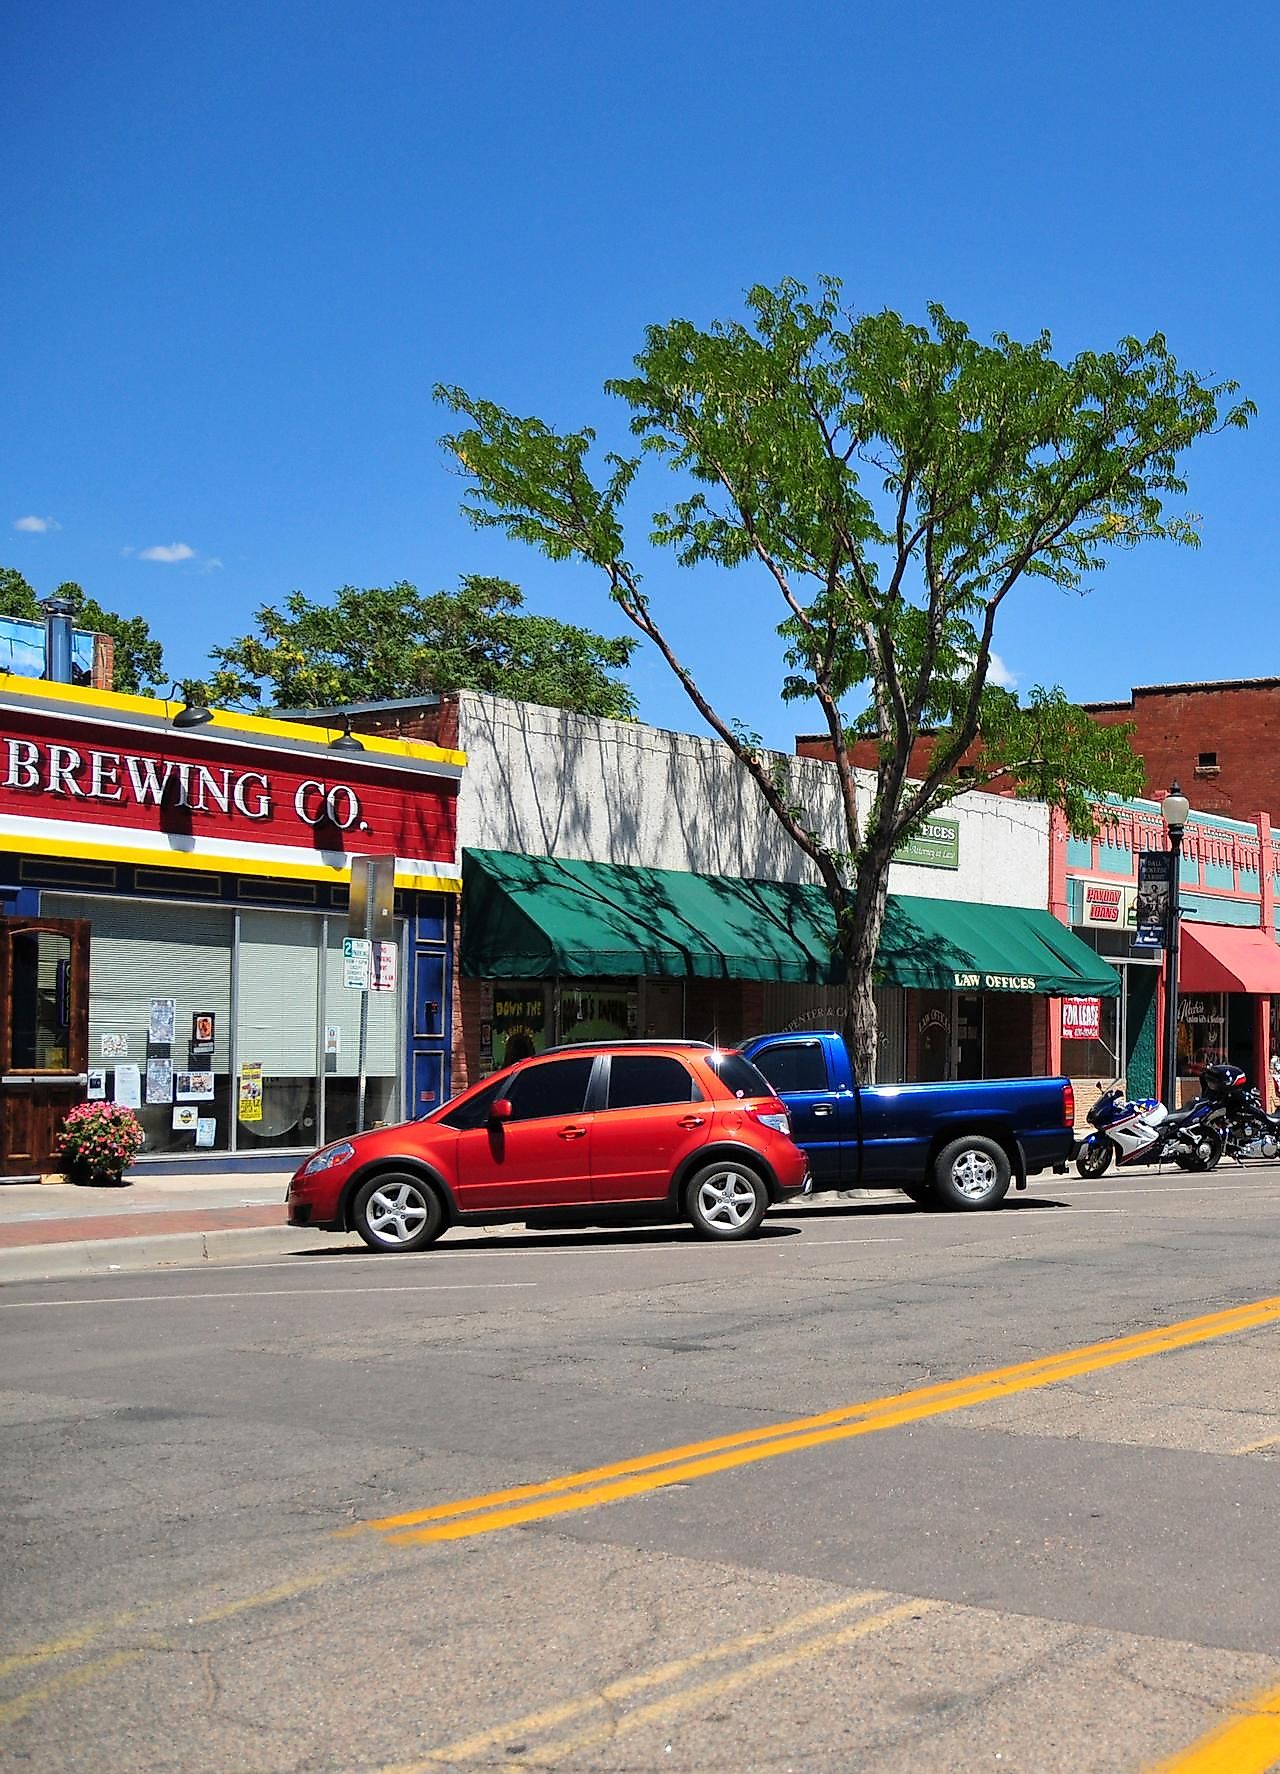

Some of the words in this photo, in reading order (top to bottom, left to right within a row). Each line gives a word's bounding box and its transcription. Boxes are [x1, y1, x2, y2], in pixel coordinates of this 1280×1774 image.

[1, 738, 271, 819] BREWING
[294, 780, 369, 831] CO.
[919, 823, 956, 840] FICES
[1086, 887, 1121, 905] PAYDAY
[1090, 904, 1120, 922] LOANS
[345, 941, 351, 955] 2
[954, 974, 981, 987] LAW
[985, 975, 1037, 989] OFFICES
[496, 1001, 523, 1017] DOWN
[526, 1001, 542, 1017] THE
[1063, 1005, 1079, 1025] FOR
